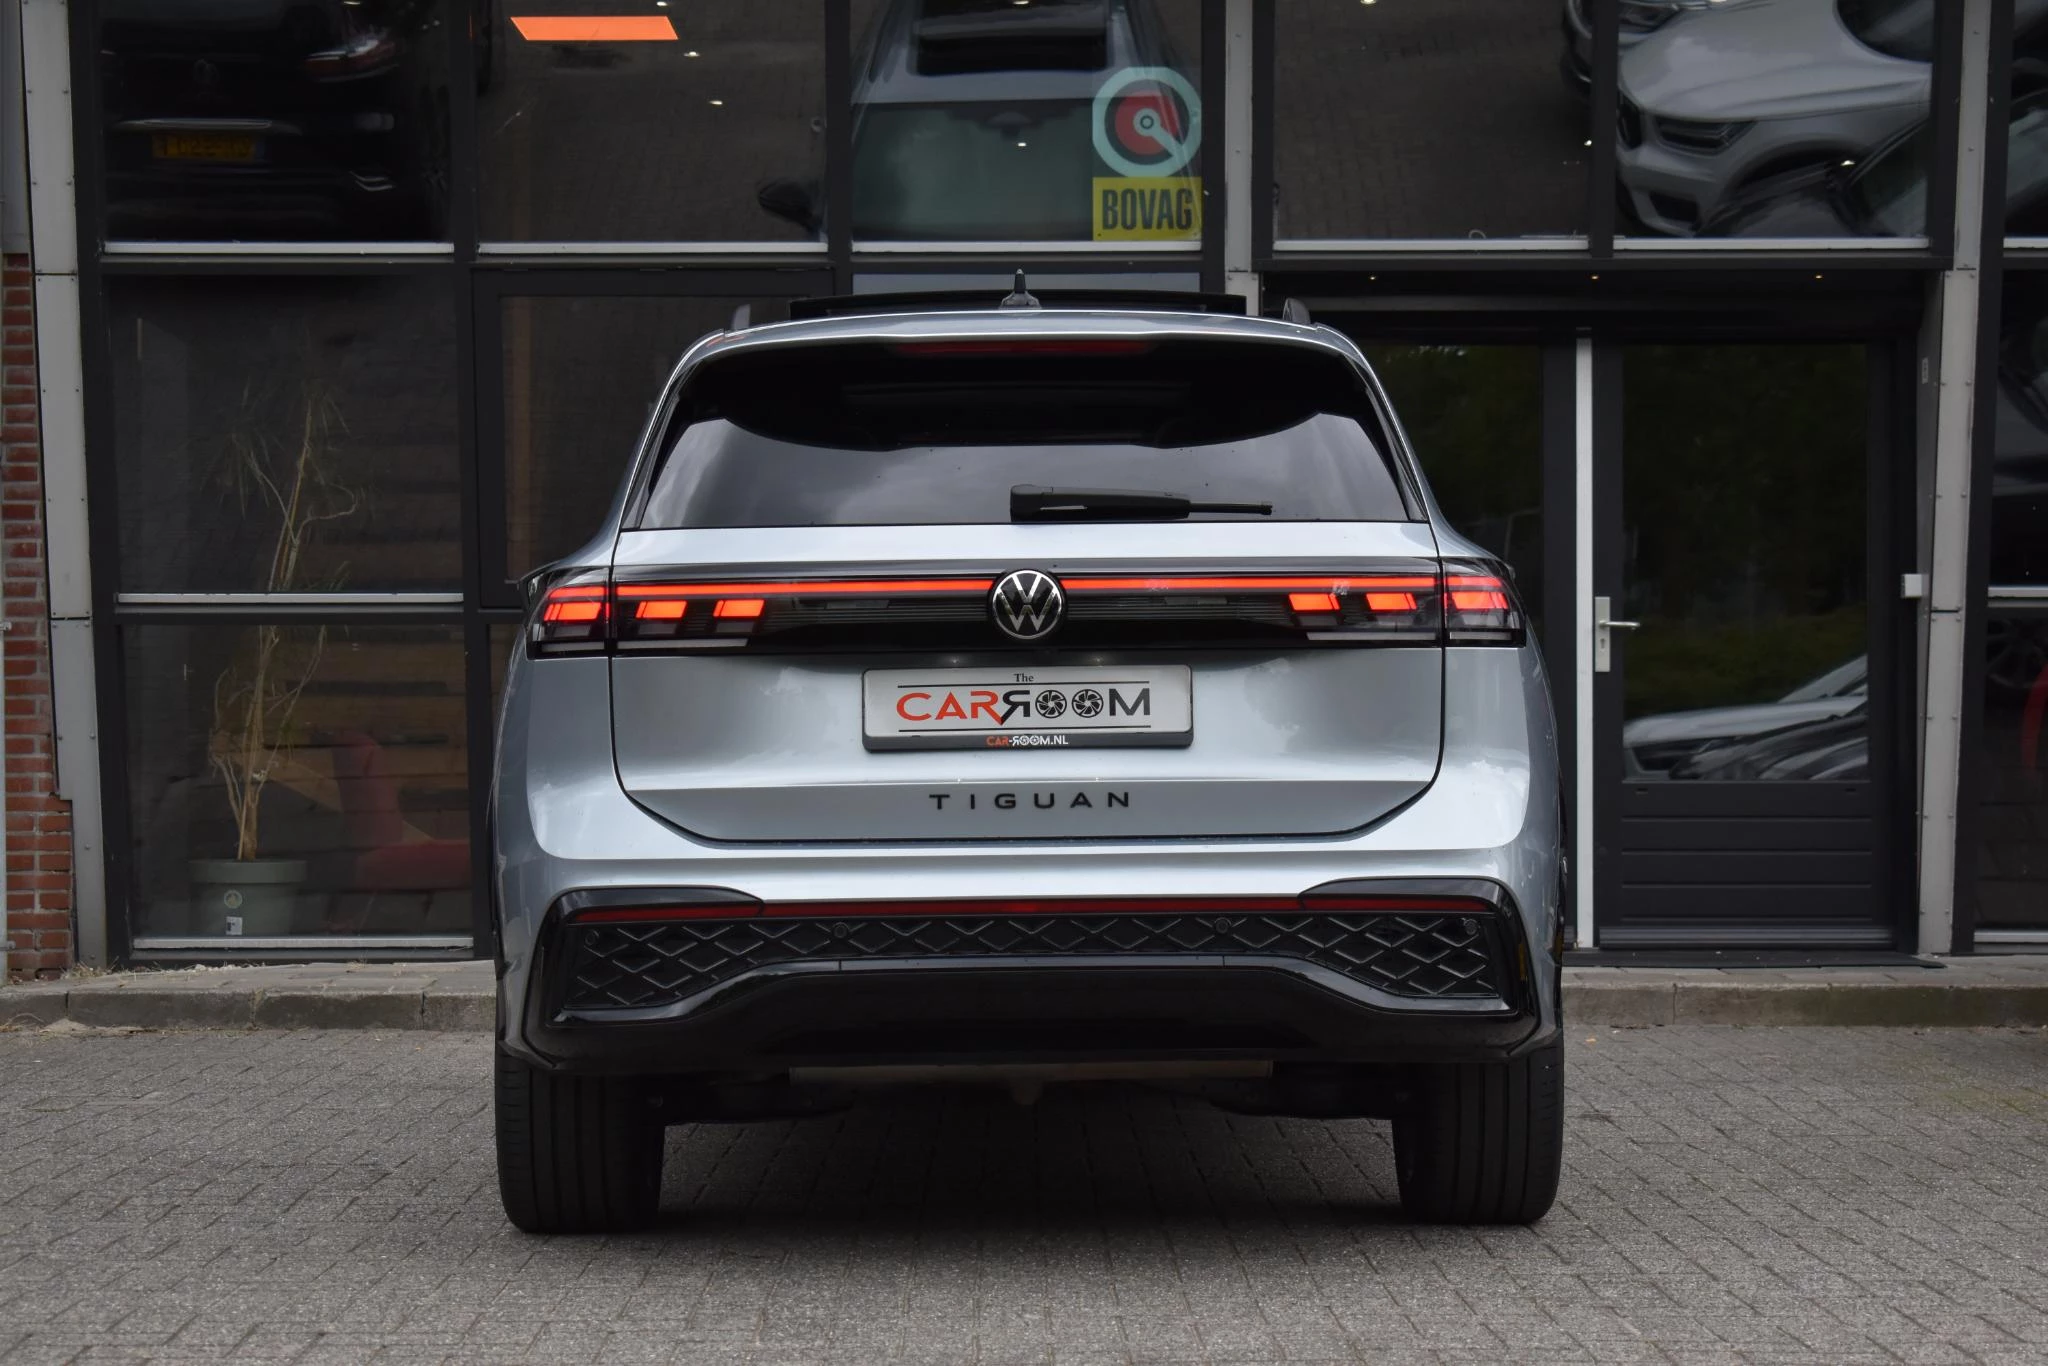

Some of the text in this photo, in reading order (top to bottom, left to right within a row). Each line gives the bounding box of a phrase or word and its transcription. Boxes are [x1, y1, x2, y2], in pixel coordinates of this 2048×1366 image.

[1101, 188, 1193, 230] BOVAG
[1014, 673, 1034, 682] The
[929, 792, 1129, 810] TIGUAN
